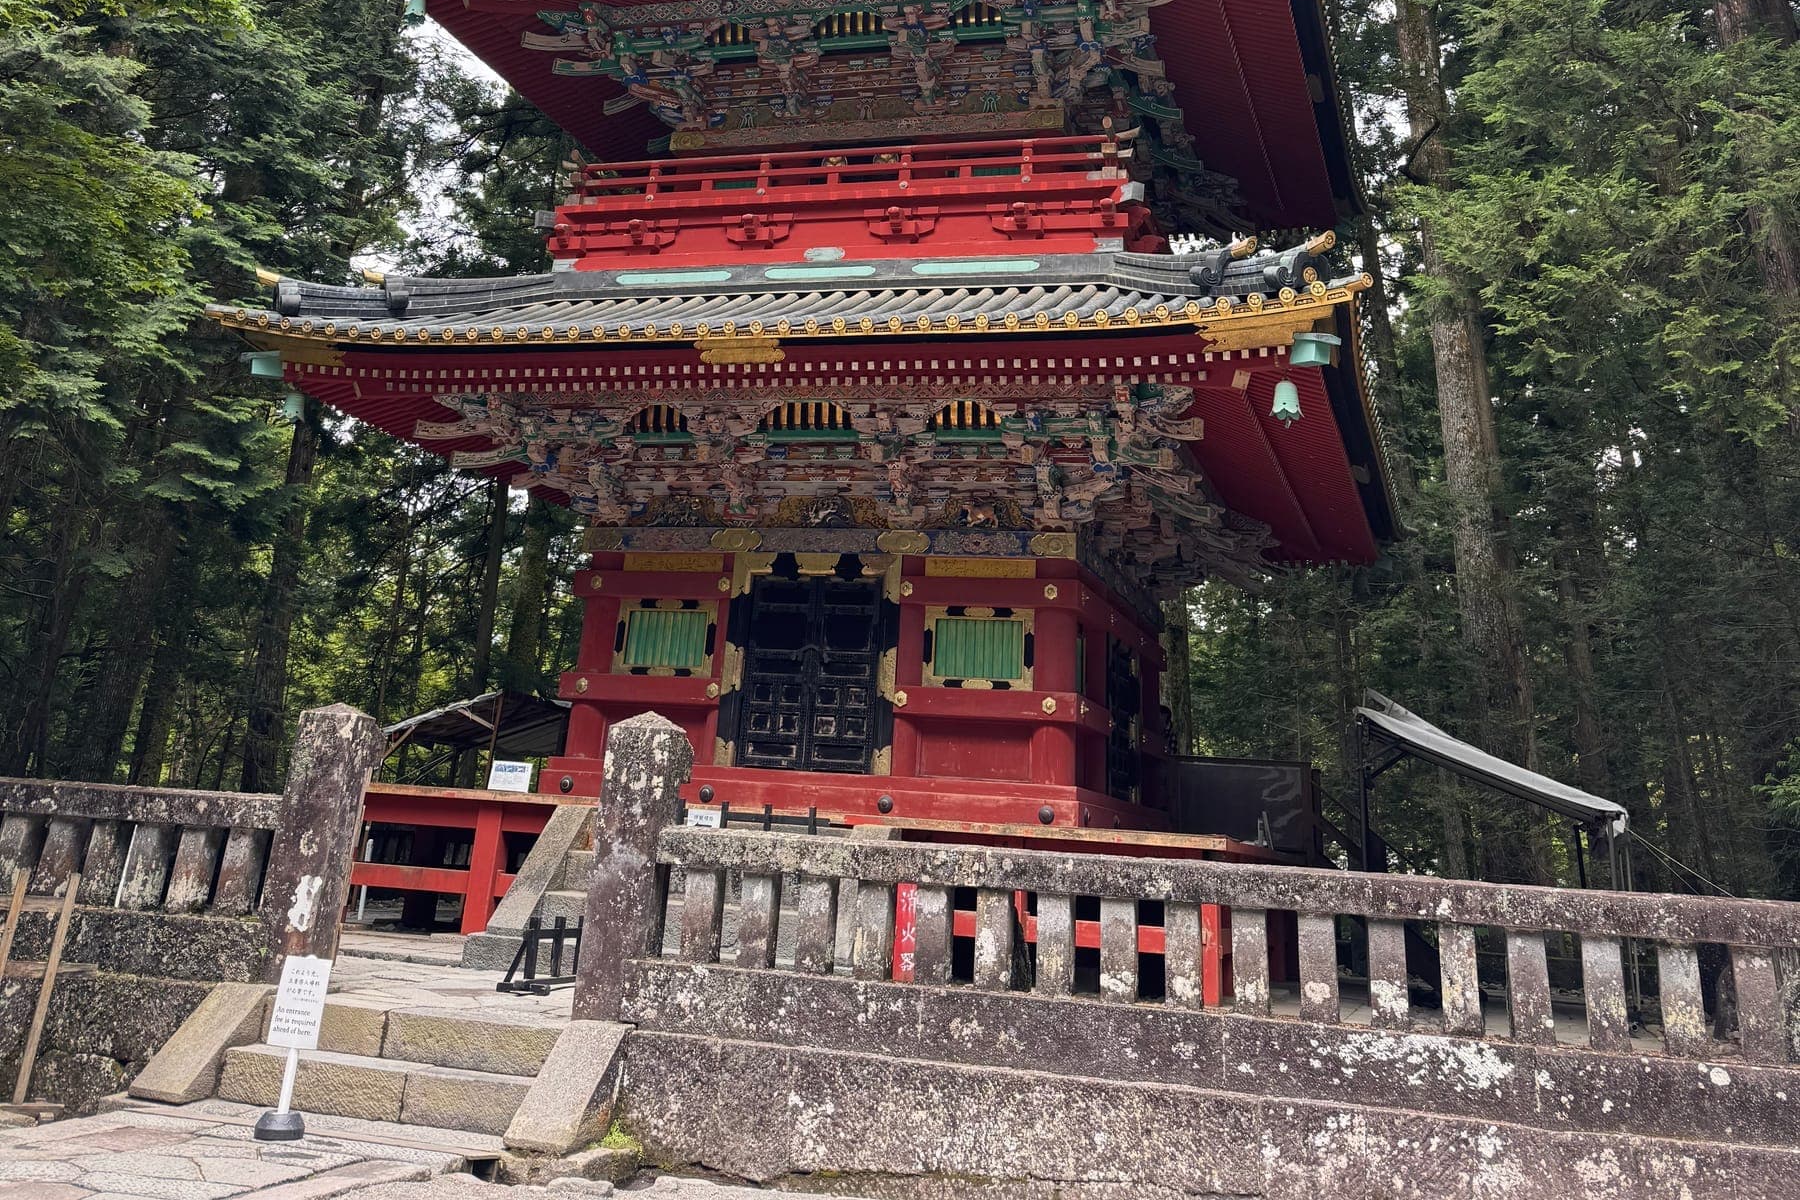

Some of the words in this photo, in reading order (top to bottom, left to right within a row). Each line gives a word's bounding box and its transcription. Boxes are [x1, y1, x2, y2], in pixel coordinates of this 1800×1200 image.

[900, 889, 918, 971] 消火器
[286, 1008, 310, 1016] entrance
[274, 1014, 284, 1023] fee
[273, 1025, 289, 1033] ahead
[290, 1026, 298, 1034] of
